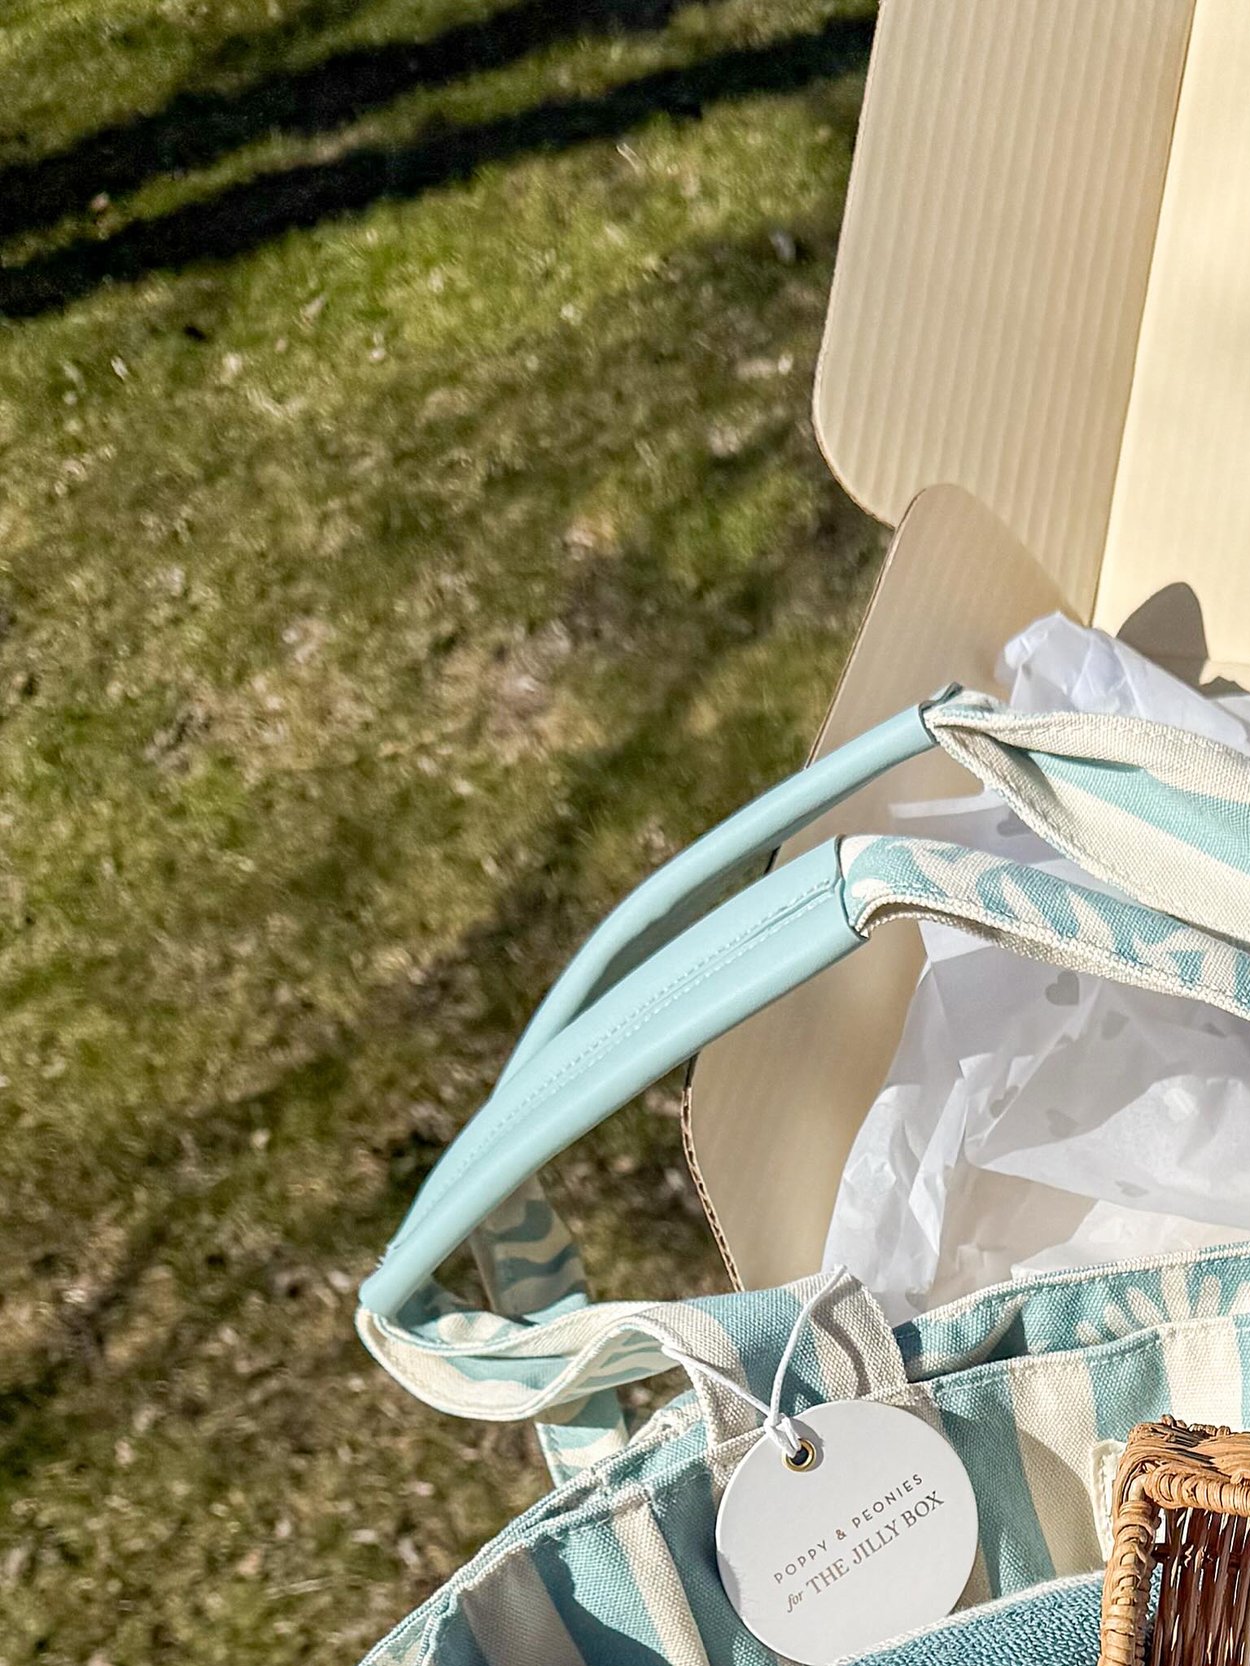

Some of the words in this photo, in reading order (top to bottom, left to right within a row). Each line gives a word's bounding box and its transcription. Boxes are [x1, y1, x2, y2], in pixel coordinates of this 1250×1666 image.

[773, 1539, 828, 1585] POPPY
[835, 1528, 848, 1541] &
[851, 1473, 924, 1529] PEONIES
[786, 1591, 805, 1613] for
[805, 1558, 850, 1596] THE
[852, 1520, 901, 1565] JILLY
[901, 1490, 945, 1529] BOX
